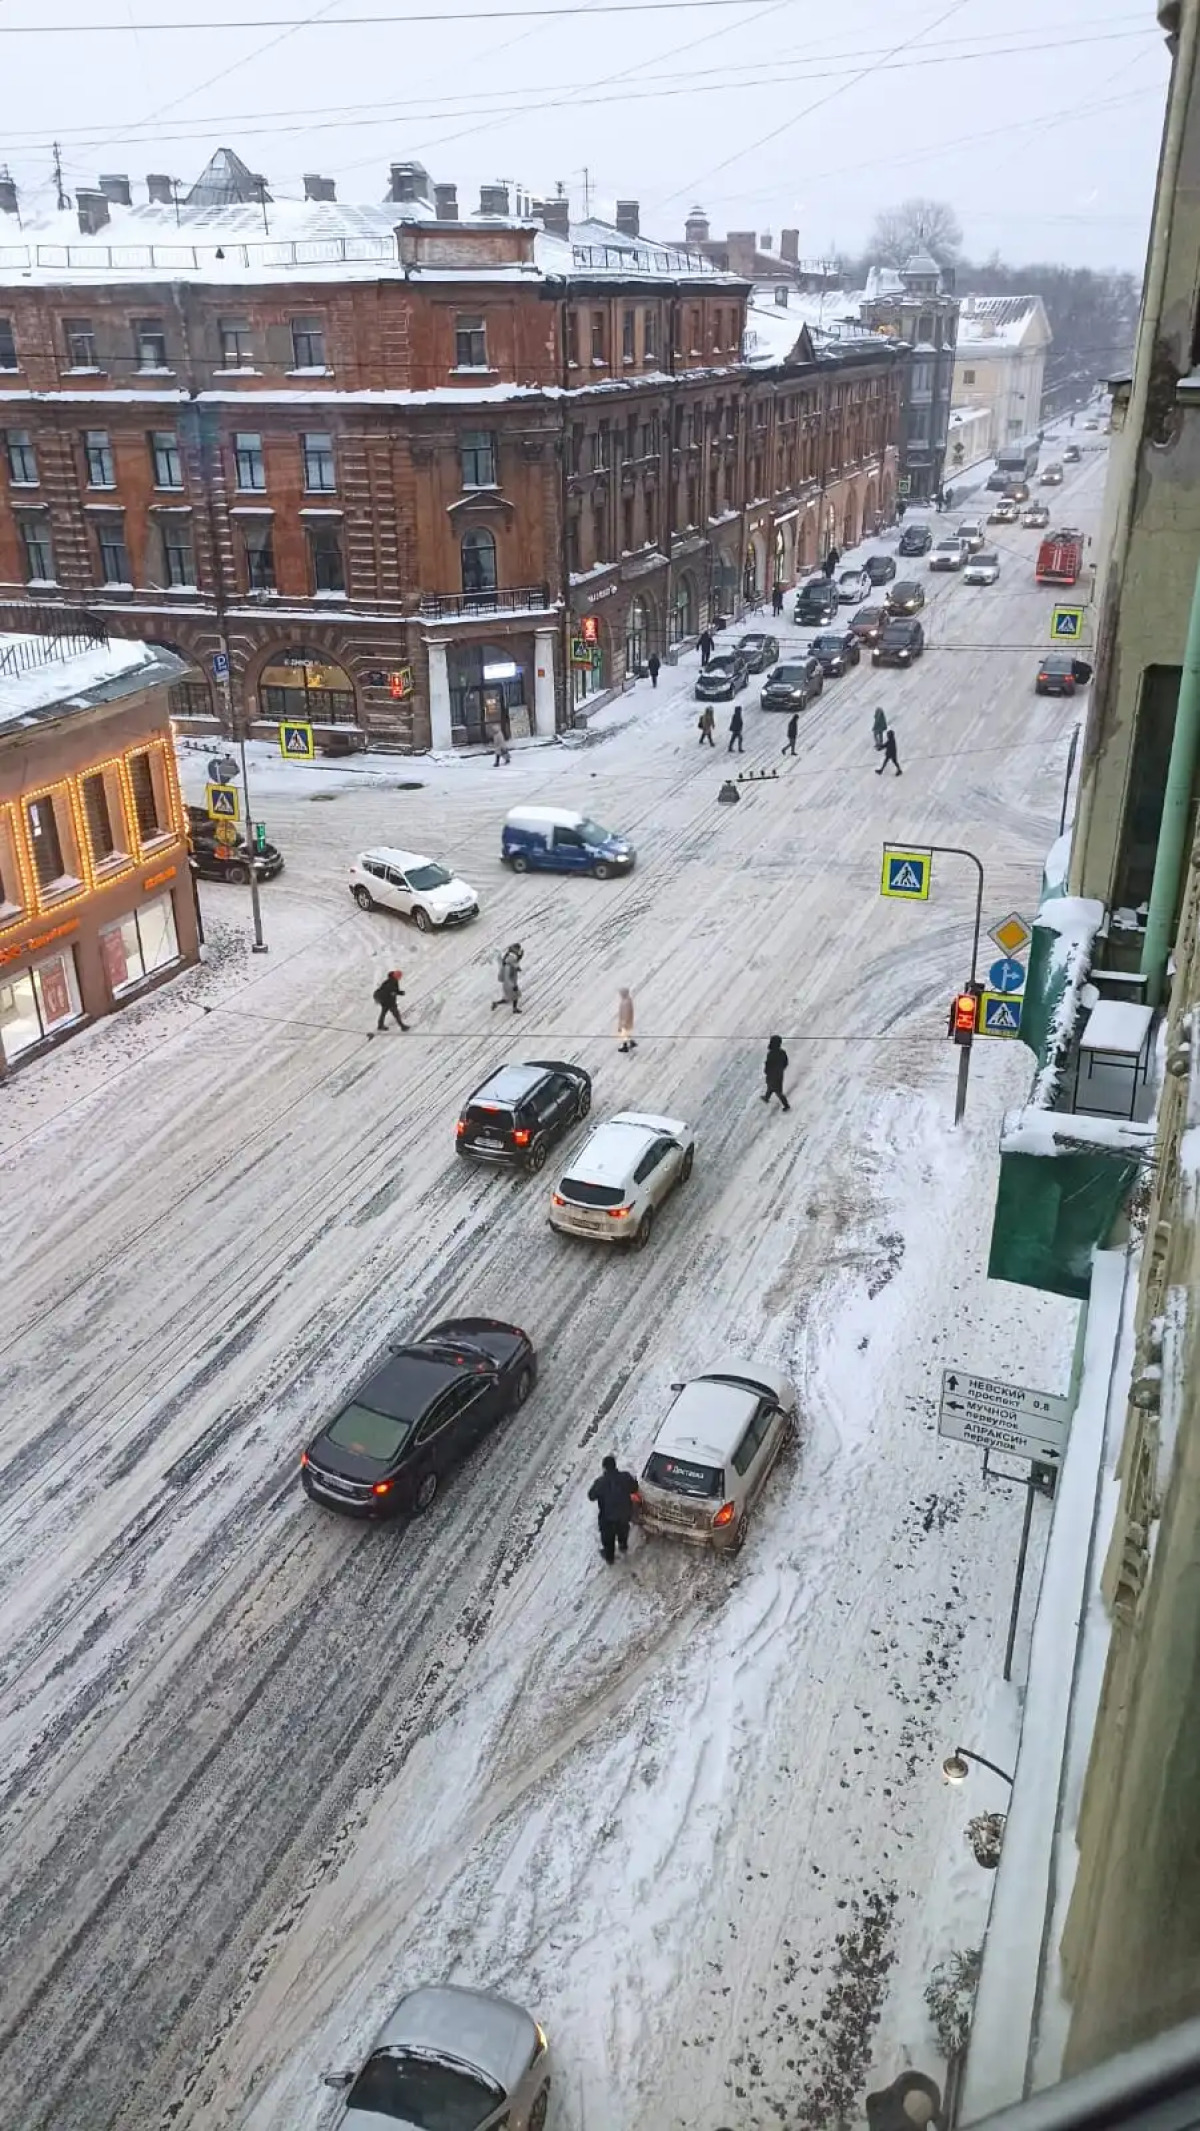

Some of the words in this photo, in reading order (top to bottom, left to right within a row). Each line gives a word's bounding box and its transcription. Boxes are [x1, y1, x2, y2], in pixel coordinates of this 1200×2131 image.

[968, 1389, 1020, 1407] проспект
[969, 1379, 1025, 1400] НЕВСКИЙ
[965, 1411, 1018, 1430] переулок
[966, 1401, 1017, 1421] МУЧНОЙ
[963, 1432, 1016, 1450] переулок
[964, 1423, 1028, 1446] АПРАКСИН
